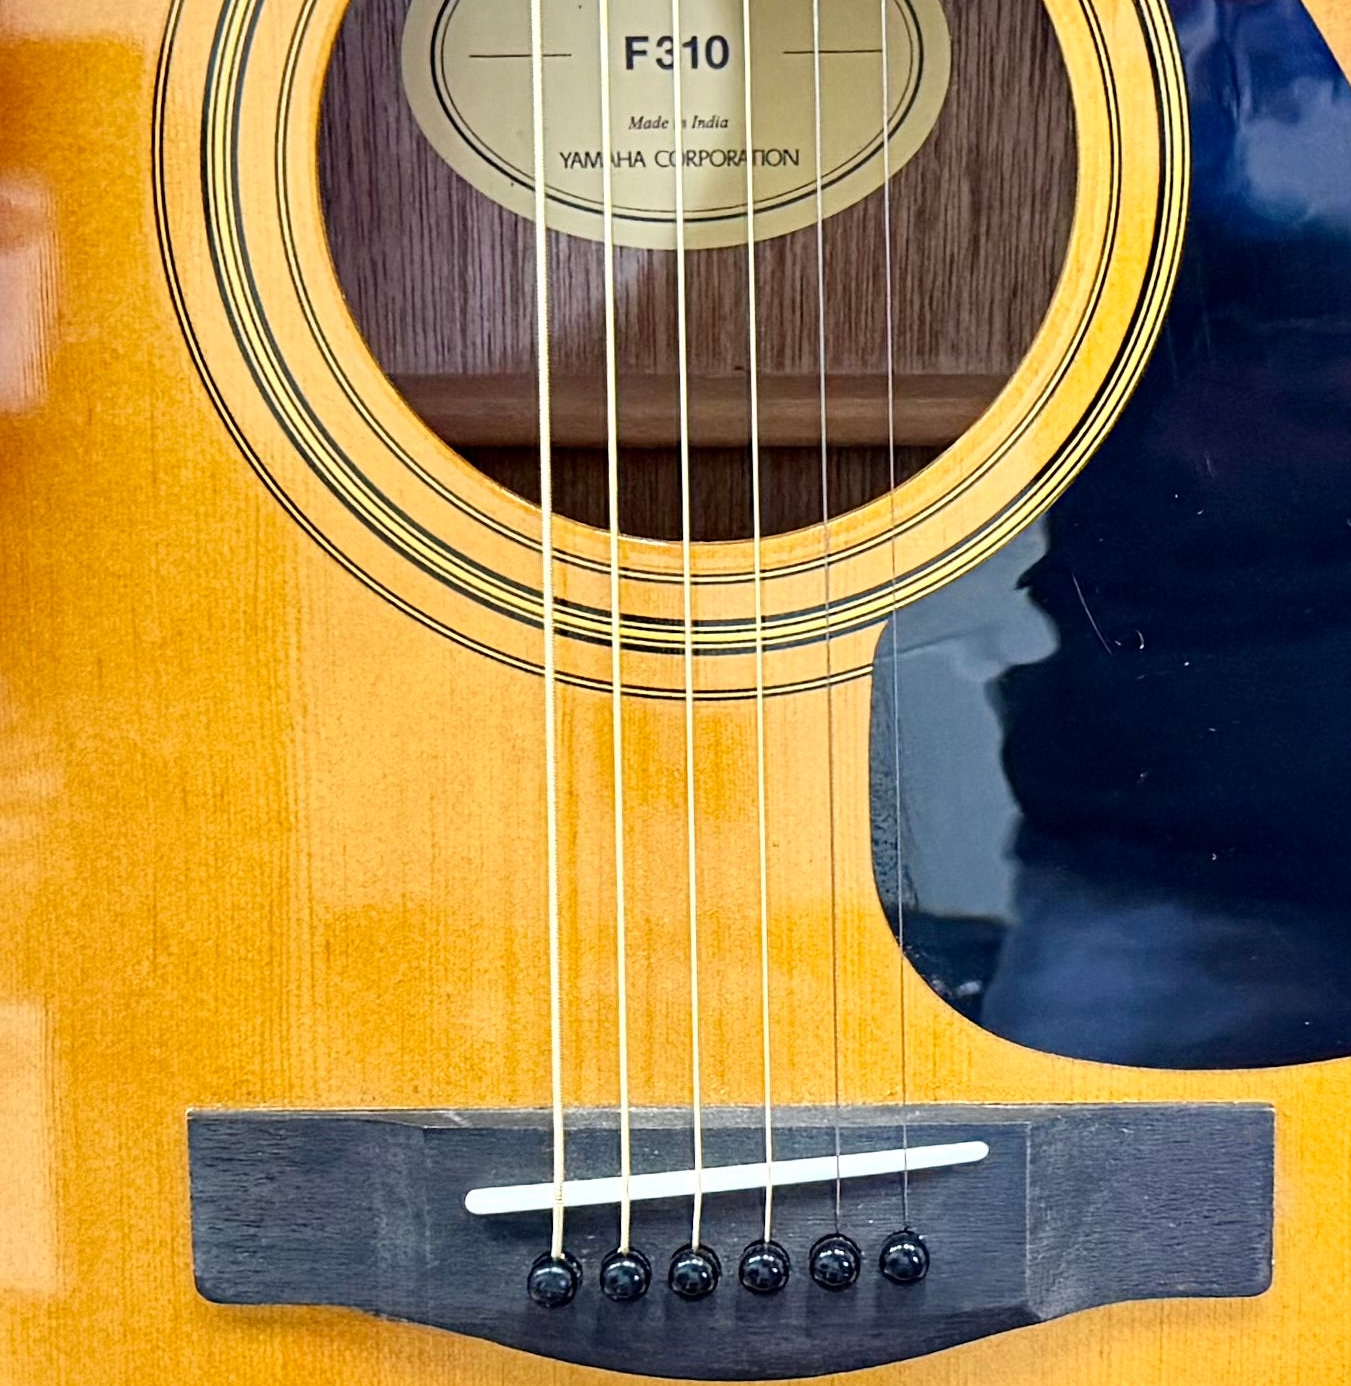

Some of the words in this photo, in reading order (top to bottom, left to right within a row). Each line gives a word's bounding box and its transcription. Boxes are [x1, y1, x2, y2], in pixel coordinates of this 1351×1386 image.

[625, 35, 730, 70] F310
[628, 115, 669, 130] Made
[691, 114, 729, 129] India
[654, 148, 800, 168] CORPORATION
